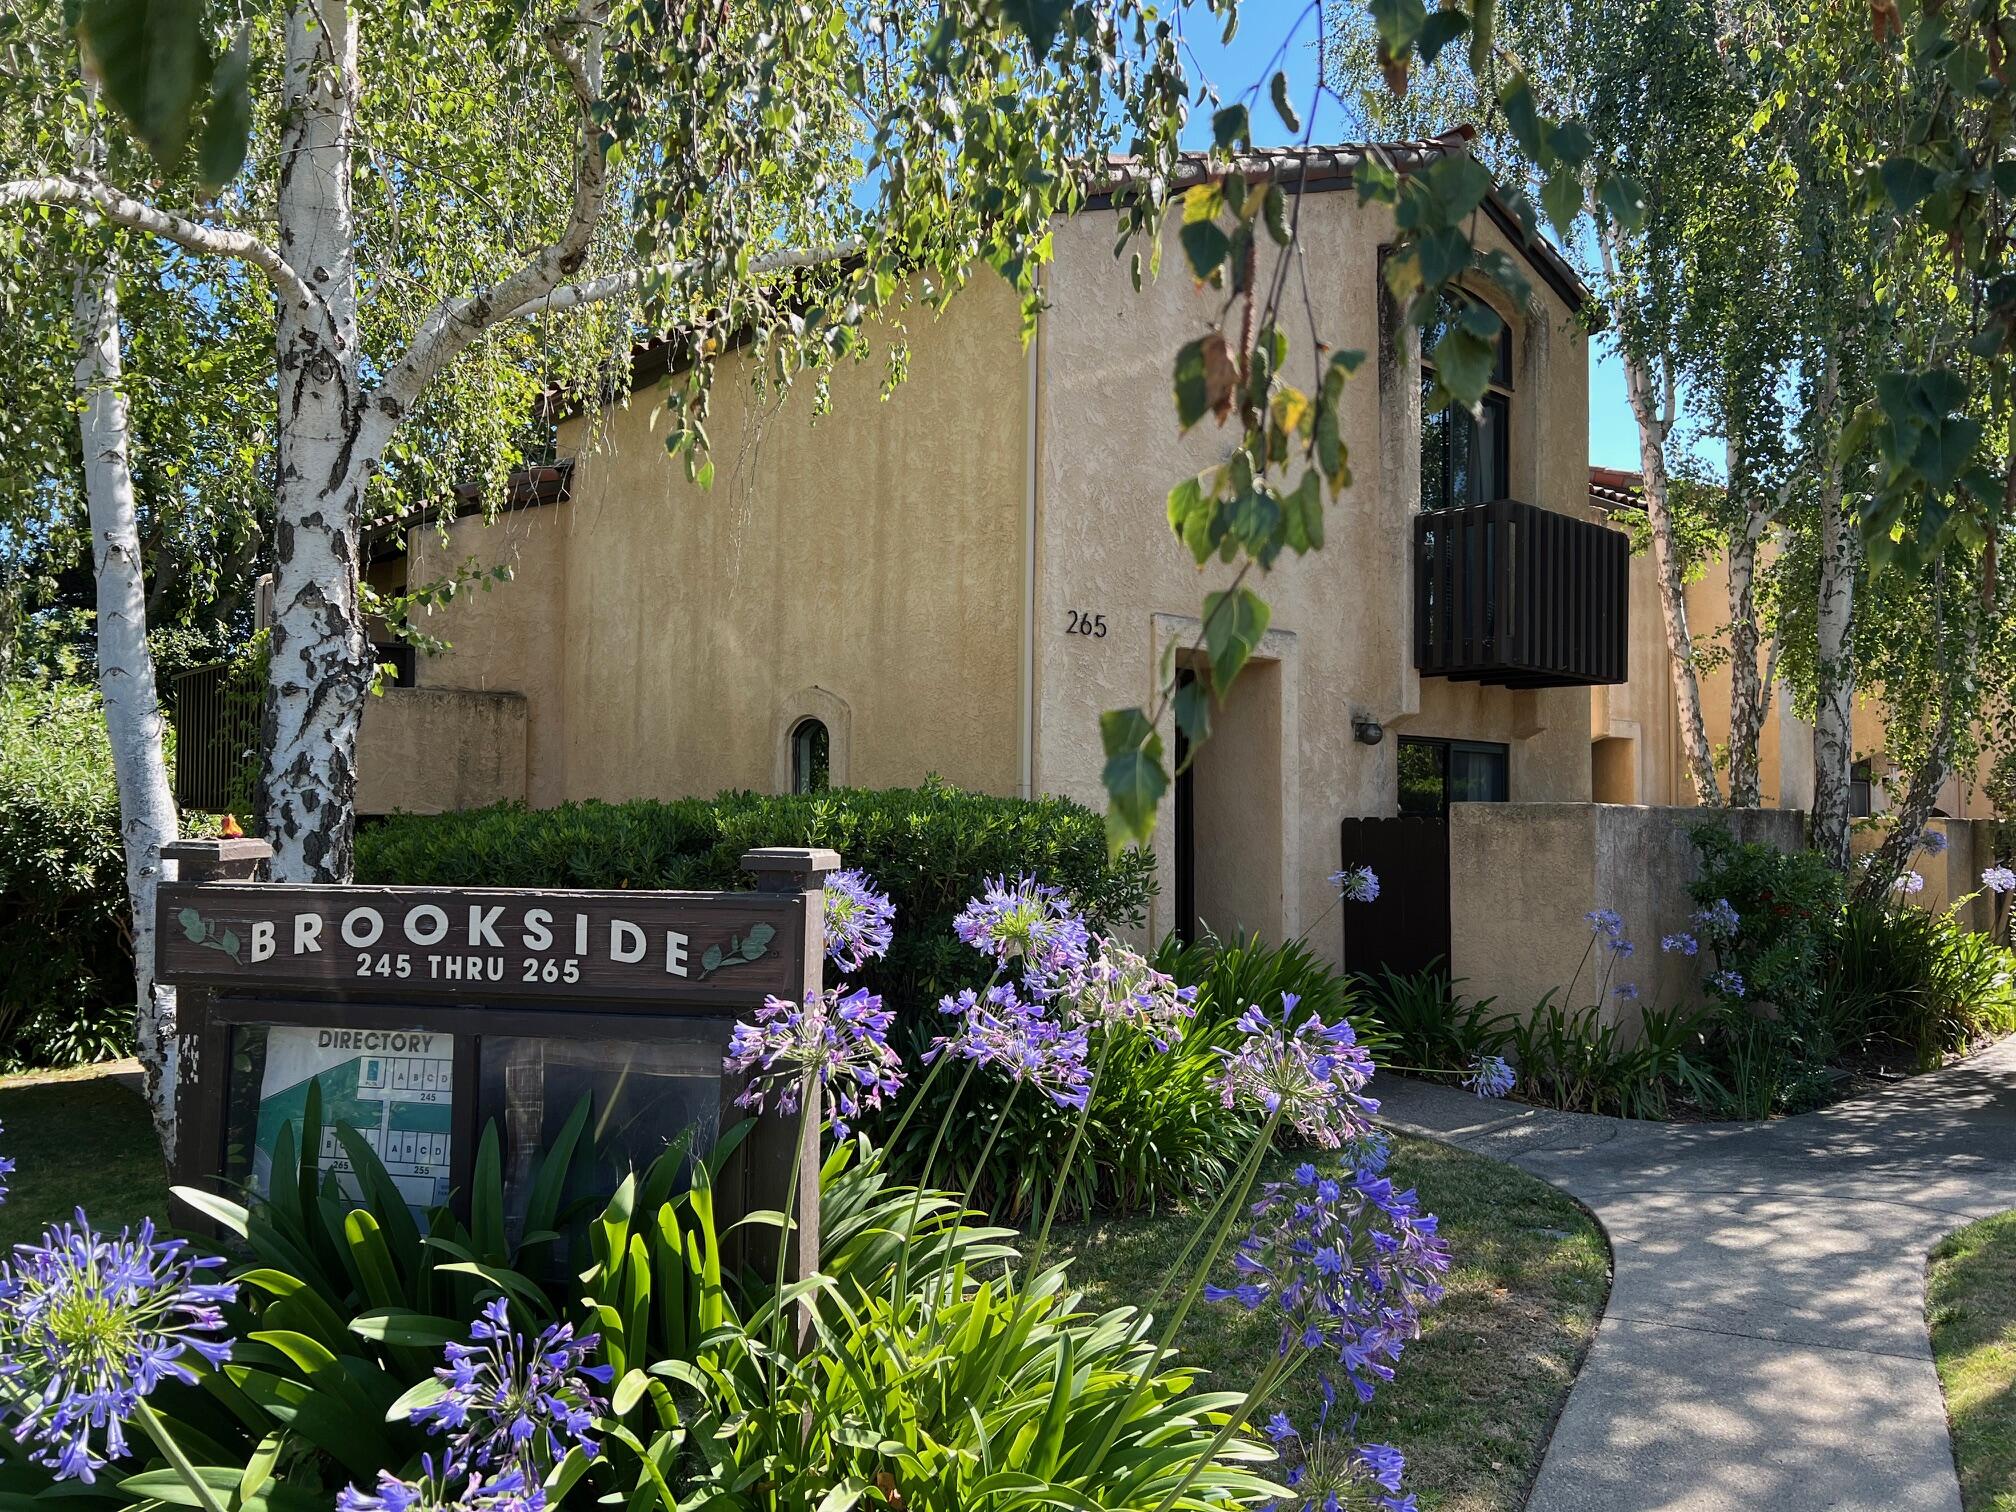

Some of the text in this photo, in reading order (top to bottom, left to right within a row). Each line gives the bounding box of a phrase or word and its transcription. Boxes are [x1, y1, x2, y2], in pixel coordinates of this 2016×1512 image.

[1065, 610, 1107, 638] 265
[250, 903, 690, 978] BROOKSIDE
[356, 952, 580, 984] 245 THRU 265
[318, 1030, 434, 1053] DIRECTORY
[397, 1072, 448, 1083] A B C D
[420, 1093, 436, 1102] 245
[391, 1145, 441, 1156] A B C D
[333, 1160, 349, 1170] 265
[414, 1166, 430, 1175] 255
